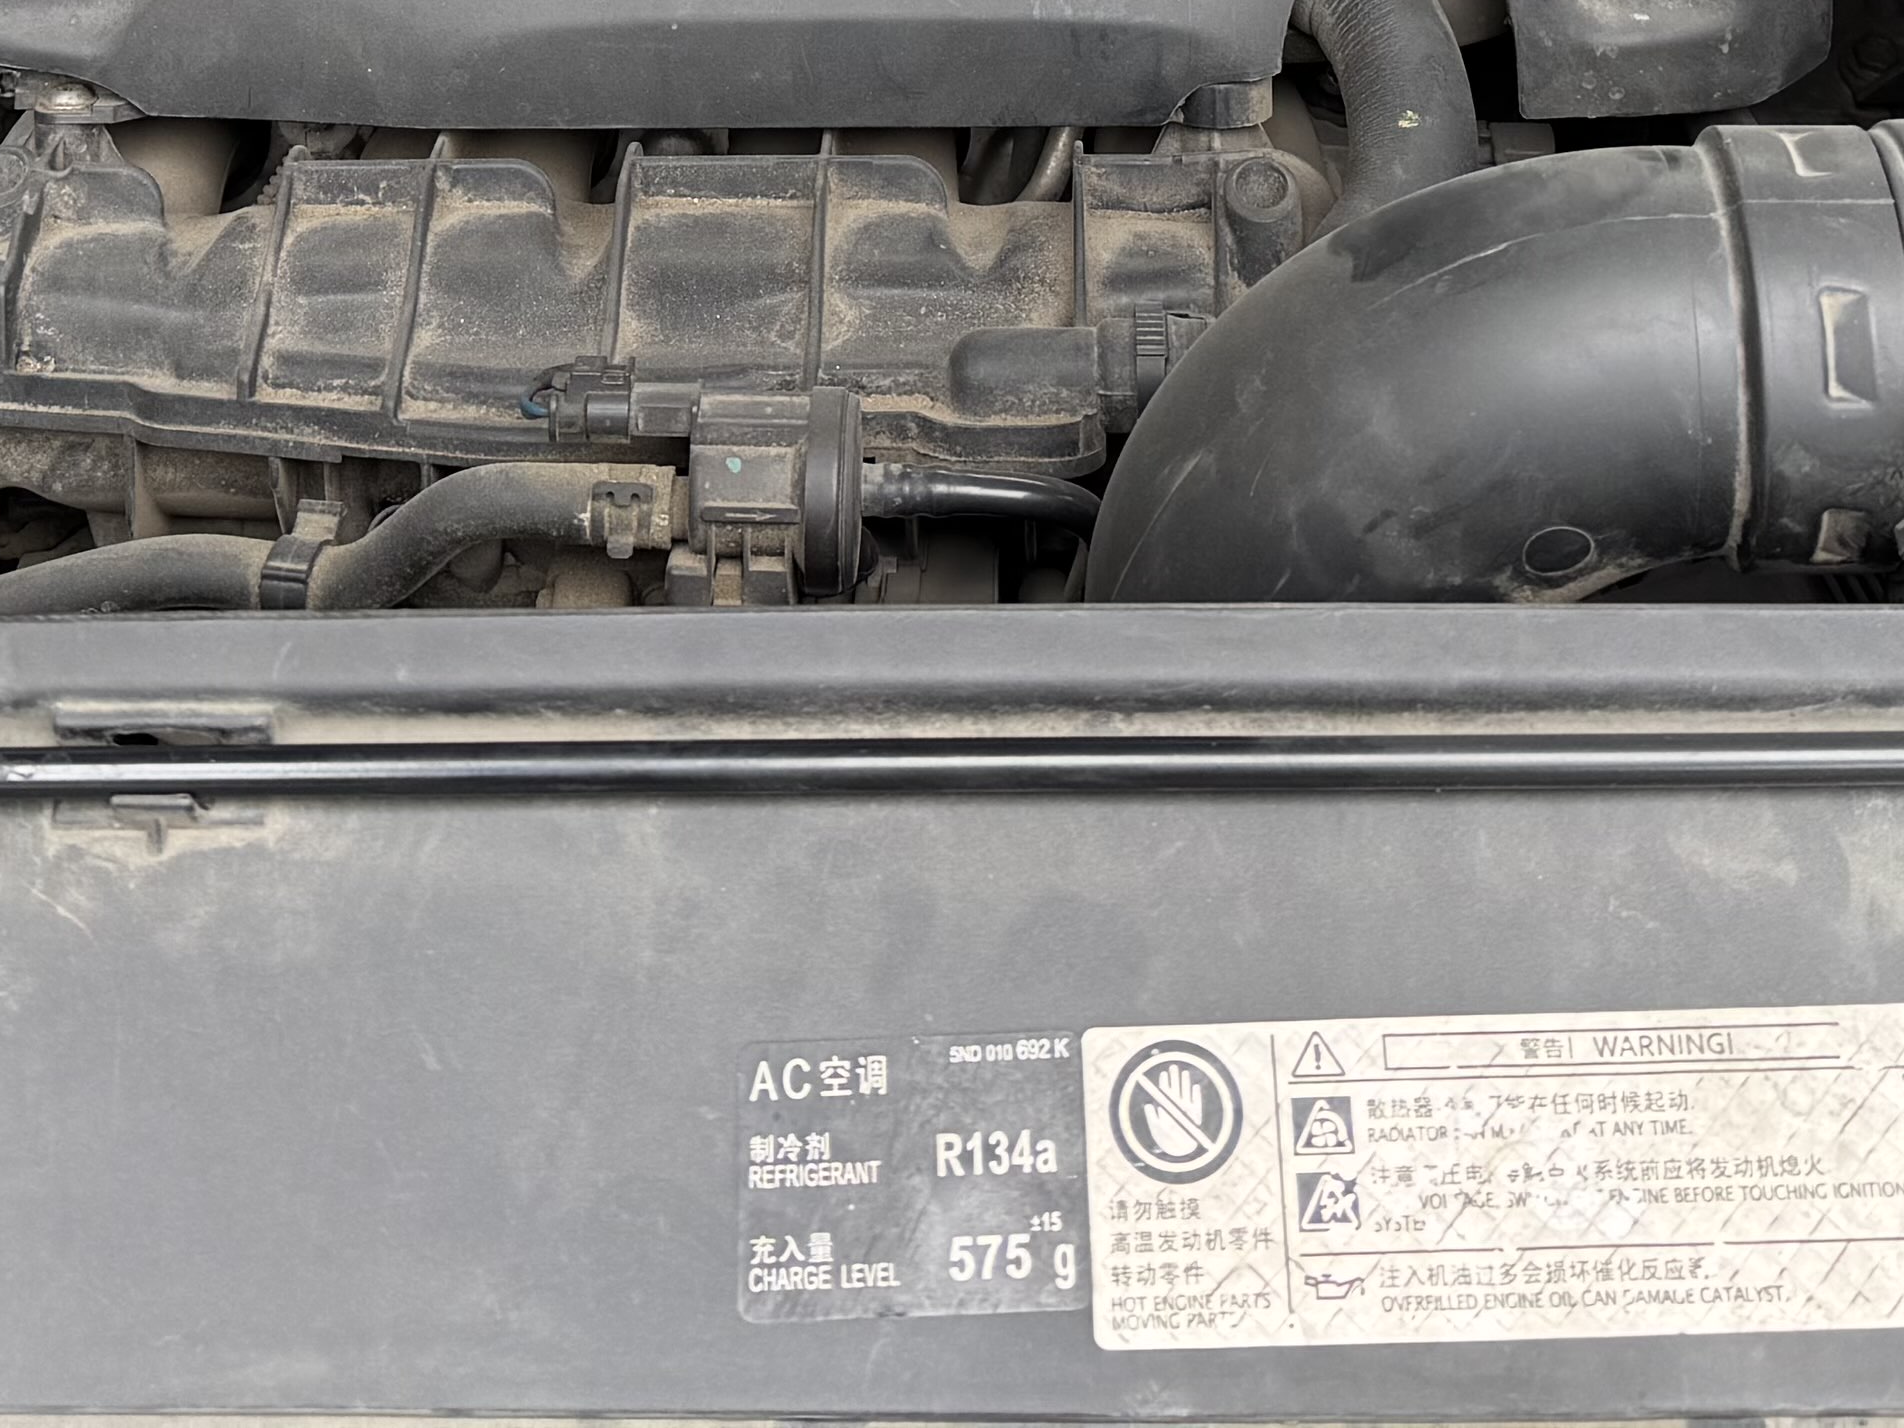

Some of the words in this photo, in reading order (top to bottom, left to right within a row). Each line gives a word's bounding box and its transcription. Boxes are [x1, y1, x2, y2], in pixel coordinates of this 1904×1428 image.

[986, 1043, 1013, 1061] 010
[1367, 1125, 1448, 1143] RADIATOR
[1612, 1119, 1645, 1136] ANY
[749, 1131, 831, 1163] 制冷剂
[936, 1129, 1058, 1177] R134a
[748, 1160, 882, 1189] REFRIGERANT
[1674, 1185, 1735, 1204] BEFORE
[1739, 1181, 1827, 1202] TOUCHING
[1030, 1211, 1063, 1232] ±15
[749, 1232, 834, 1265] 充入量
[1110, 1227, 1274, 1255] 高温发动机零件
[949, 1233, 1033, 1282] 575
[1054, 1241, 1077, 1290] g
[1111, 1260, 1205, 1287] 转动零件
[748, 1265, 833, 1293] CHARGE
[841, 1261, 901, 1290] LEVEL
[1111, 1295, 1147, 1313] HOT
[1153, 1293, 1214, 1312] ENGINE
[1220, 1292, 1272, 1309] PARTS
[1484, 1291, 1544, 1310] ENGINE
[1549, 1291, 1579, 1308] OIL
[1581, 1289, 1617, 1307] CAN
[1111, 1311, 1181, 1331] MOVING
